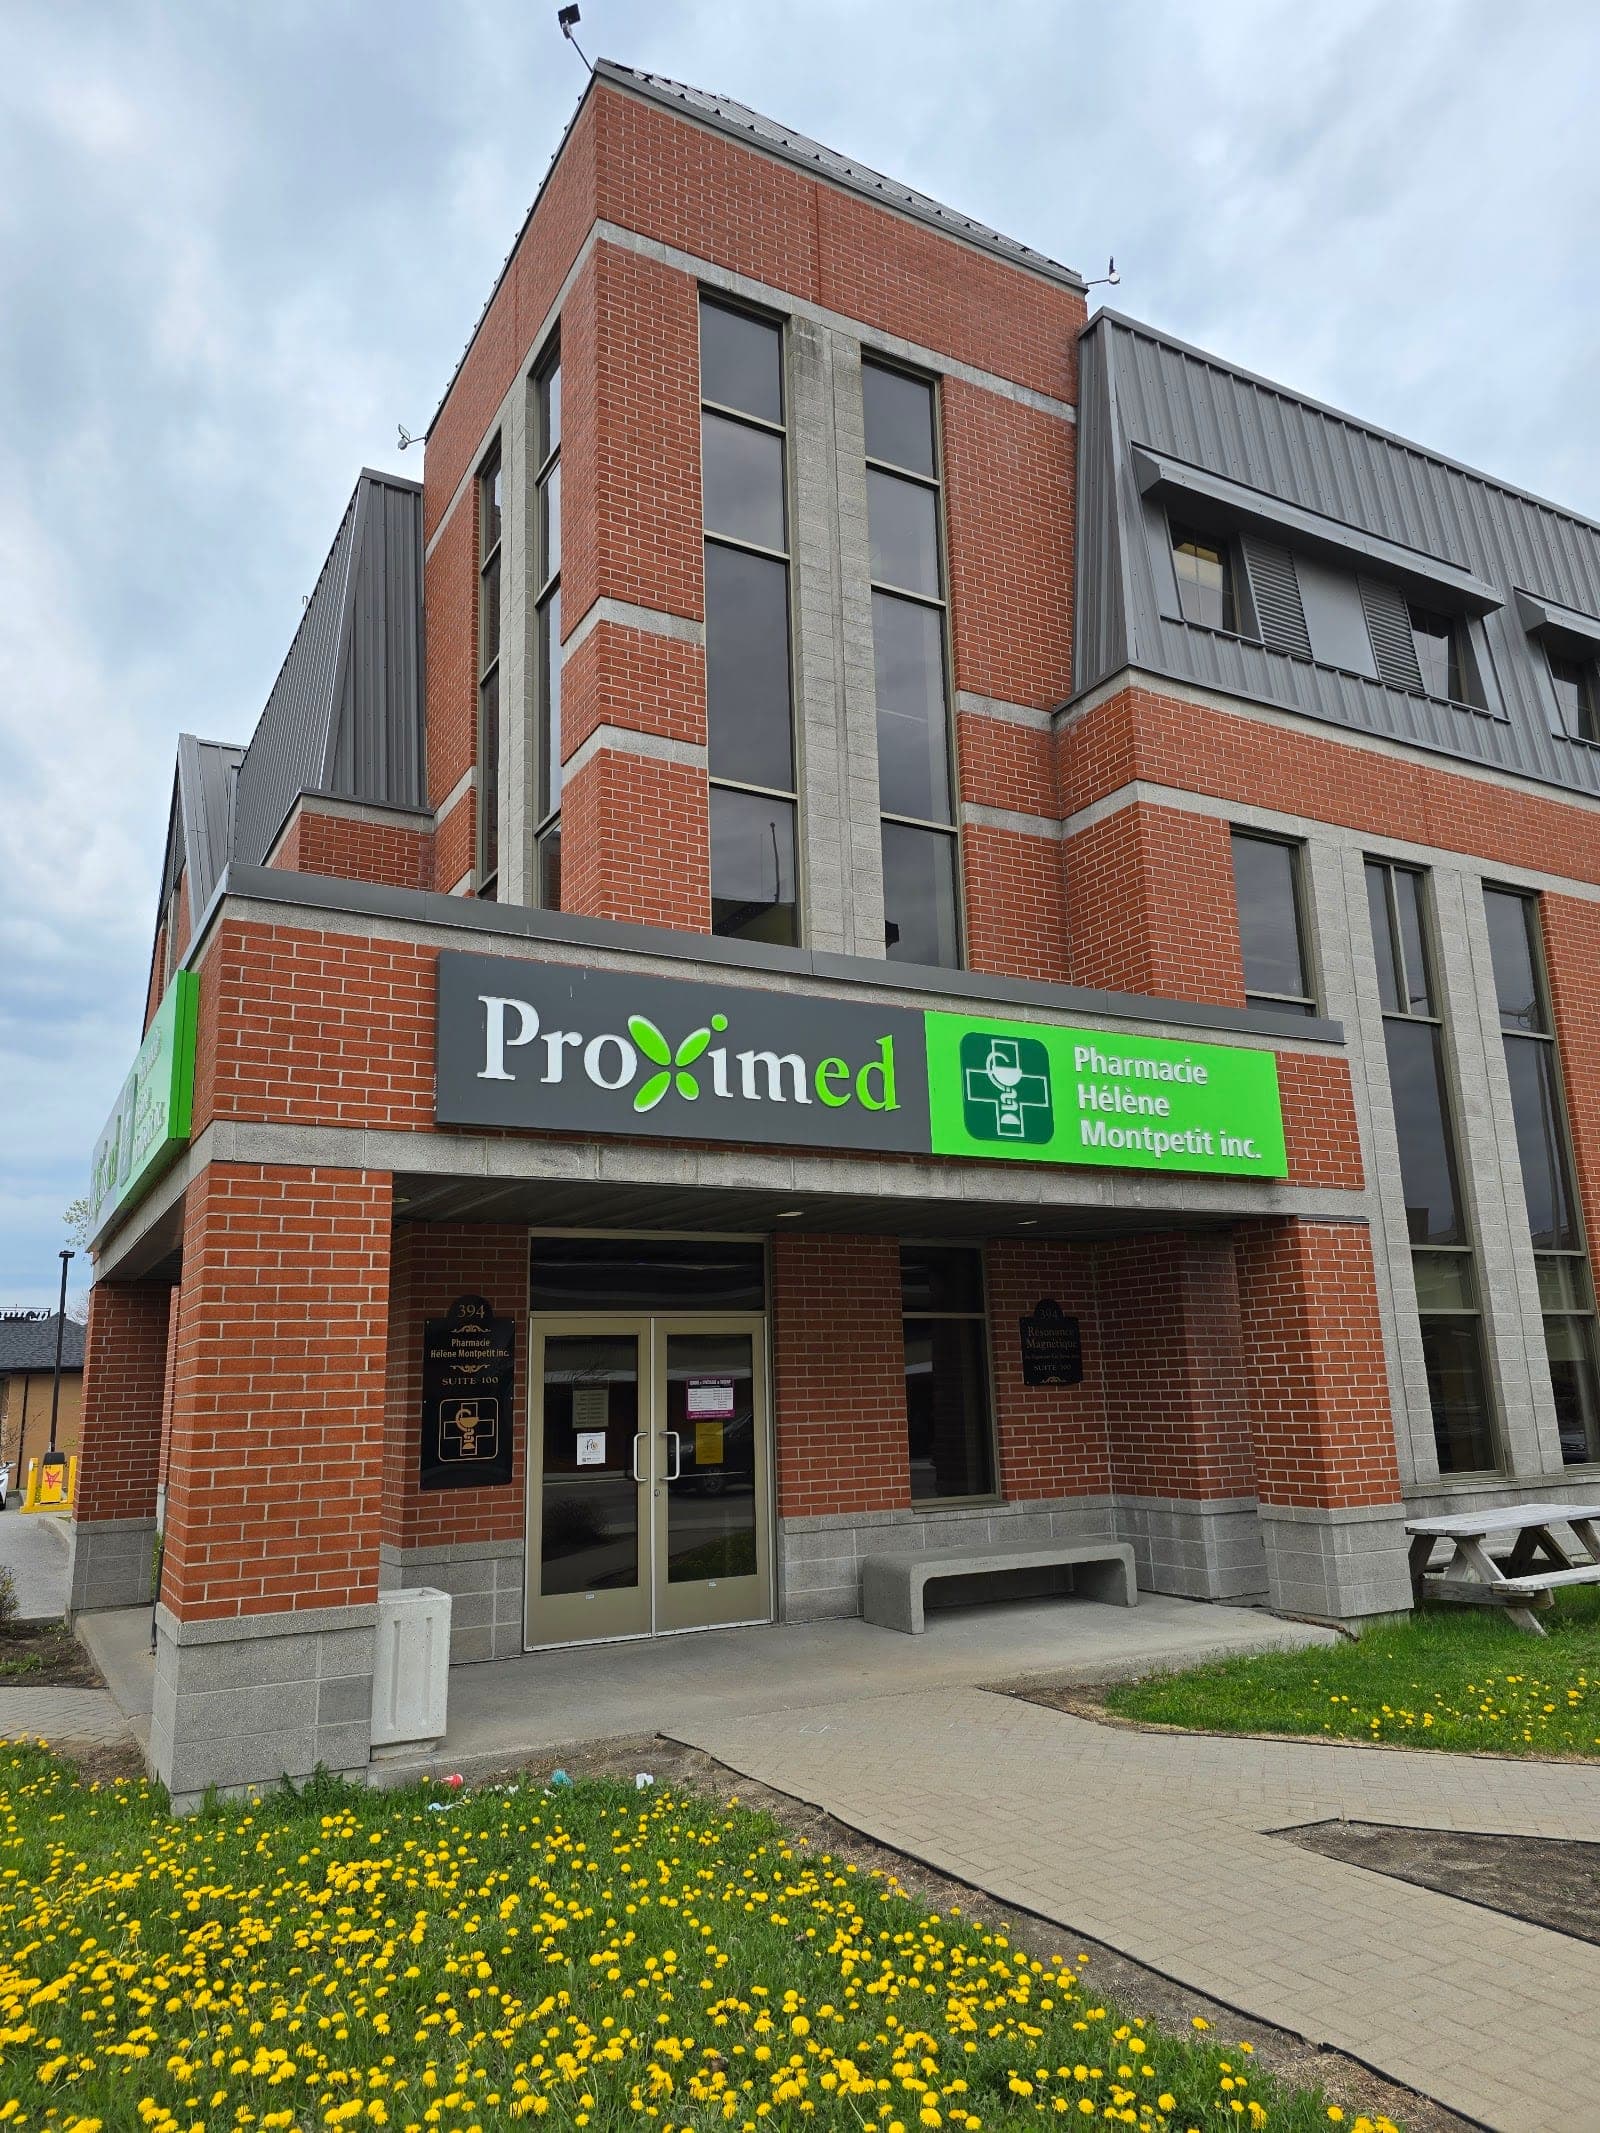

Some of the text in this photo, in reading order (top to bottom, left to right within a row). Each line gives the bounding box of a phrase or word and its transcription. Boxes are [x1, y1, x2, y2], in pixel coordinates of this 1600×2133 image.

[476, 995, 902, 1113] Proximed
[1074, 1045, 1208, 1085] Pharmacie
[1077, 1083, 1170, 1117] Hélène
[1080, 1119, 1262, 1159] Montpetit inc.
[456, 1304, 485, 1319] 394
[451, 1338, 491, 1347] Pharmacie
[458, 1349, 496, 1360] Montpetit
[441, 1376, 499, 1386] SUITE 100
